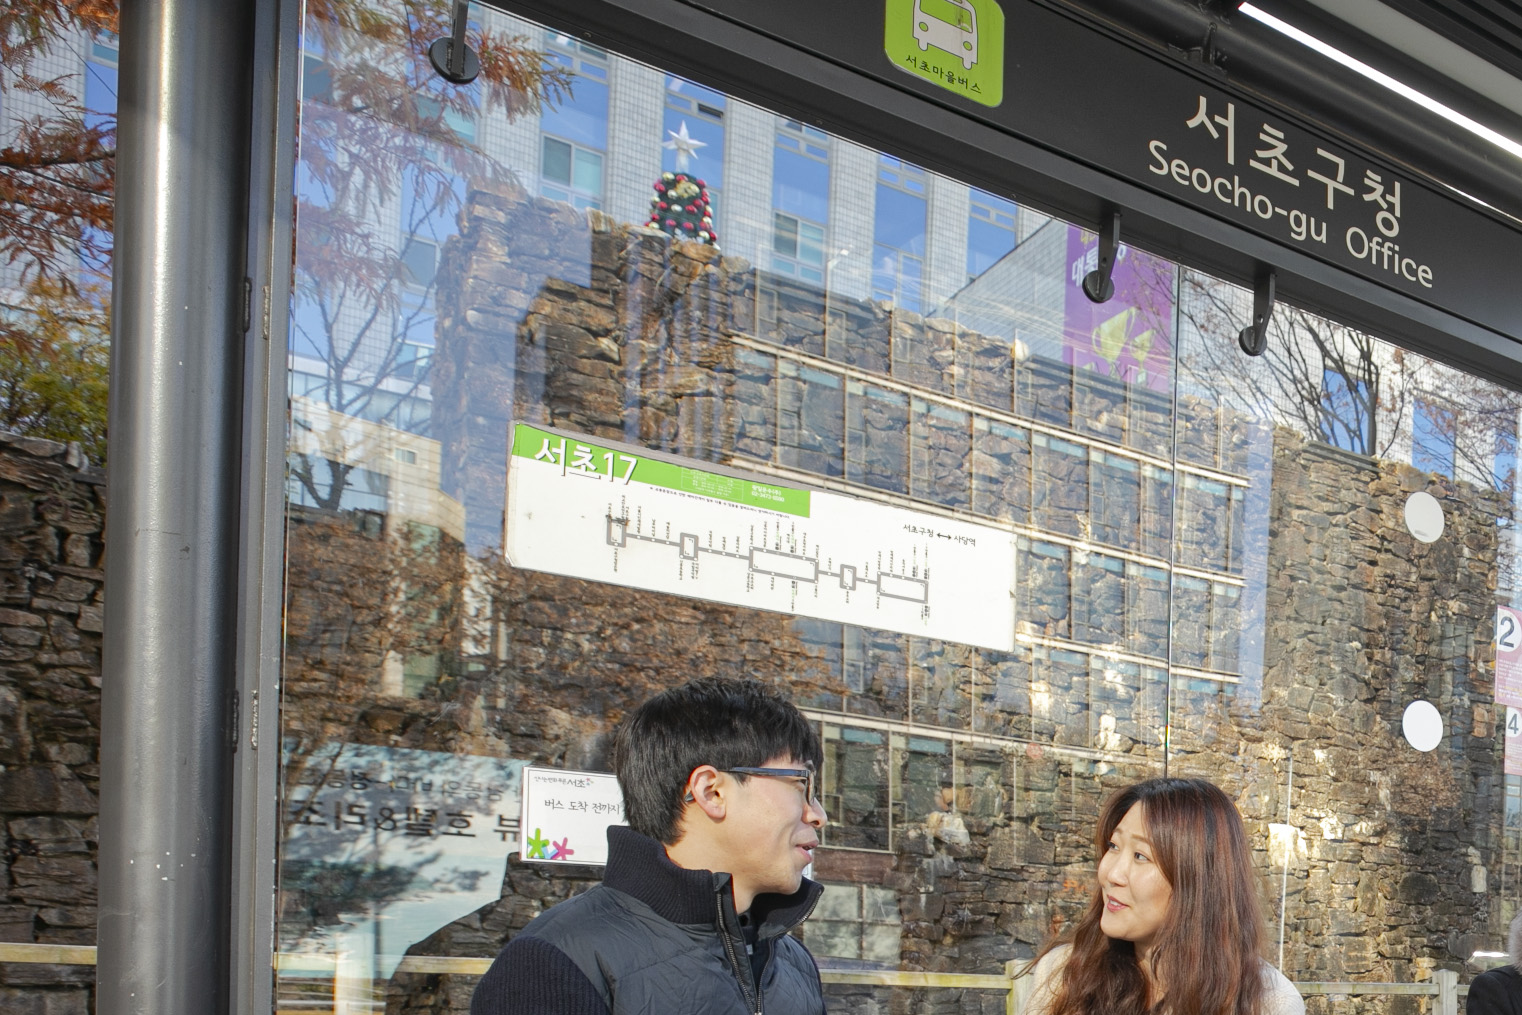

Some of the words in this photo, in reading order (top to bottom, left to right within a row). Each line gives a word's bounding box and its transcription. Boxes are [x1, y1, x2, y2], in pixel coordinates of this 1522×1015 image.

[905, 55, 982, 94] 서초마을버스
[1185, 95, 1401, 238] 서초구청
[1148, 139, 1328, 244] Seocho-gu
[1345, 226, 1434, 288] Office
[534, 438, 638, 485] 서초17
[1499, 616, 1515, 648] 2
[1507, 713, 1519, 734] 4
[544, 798, 565, 810] 버스
[568, 801, 588, 812] 도착
[592, 803, 620, 815] 전까지
